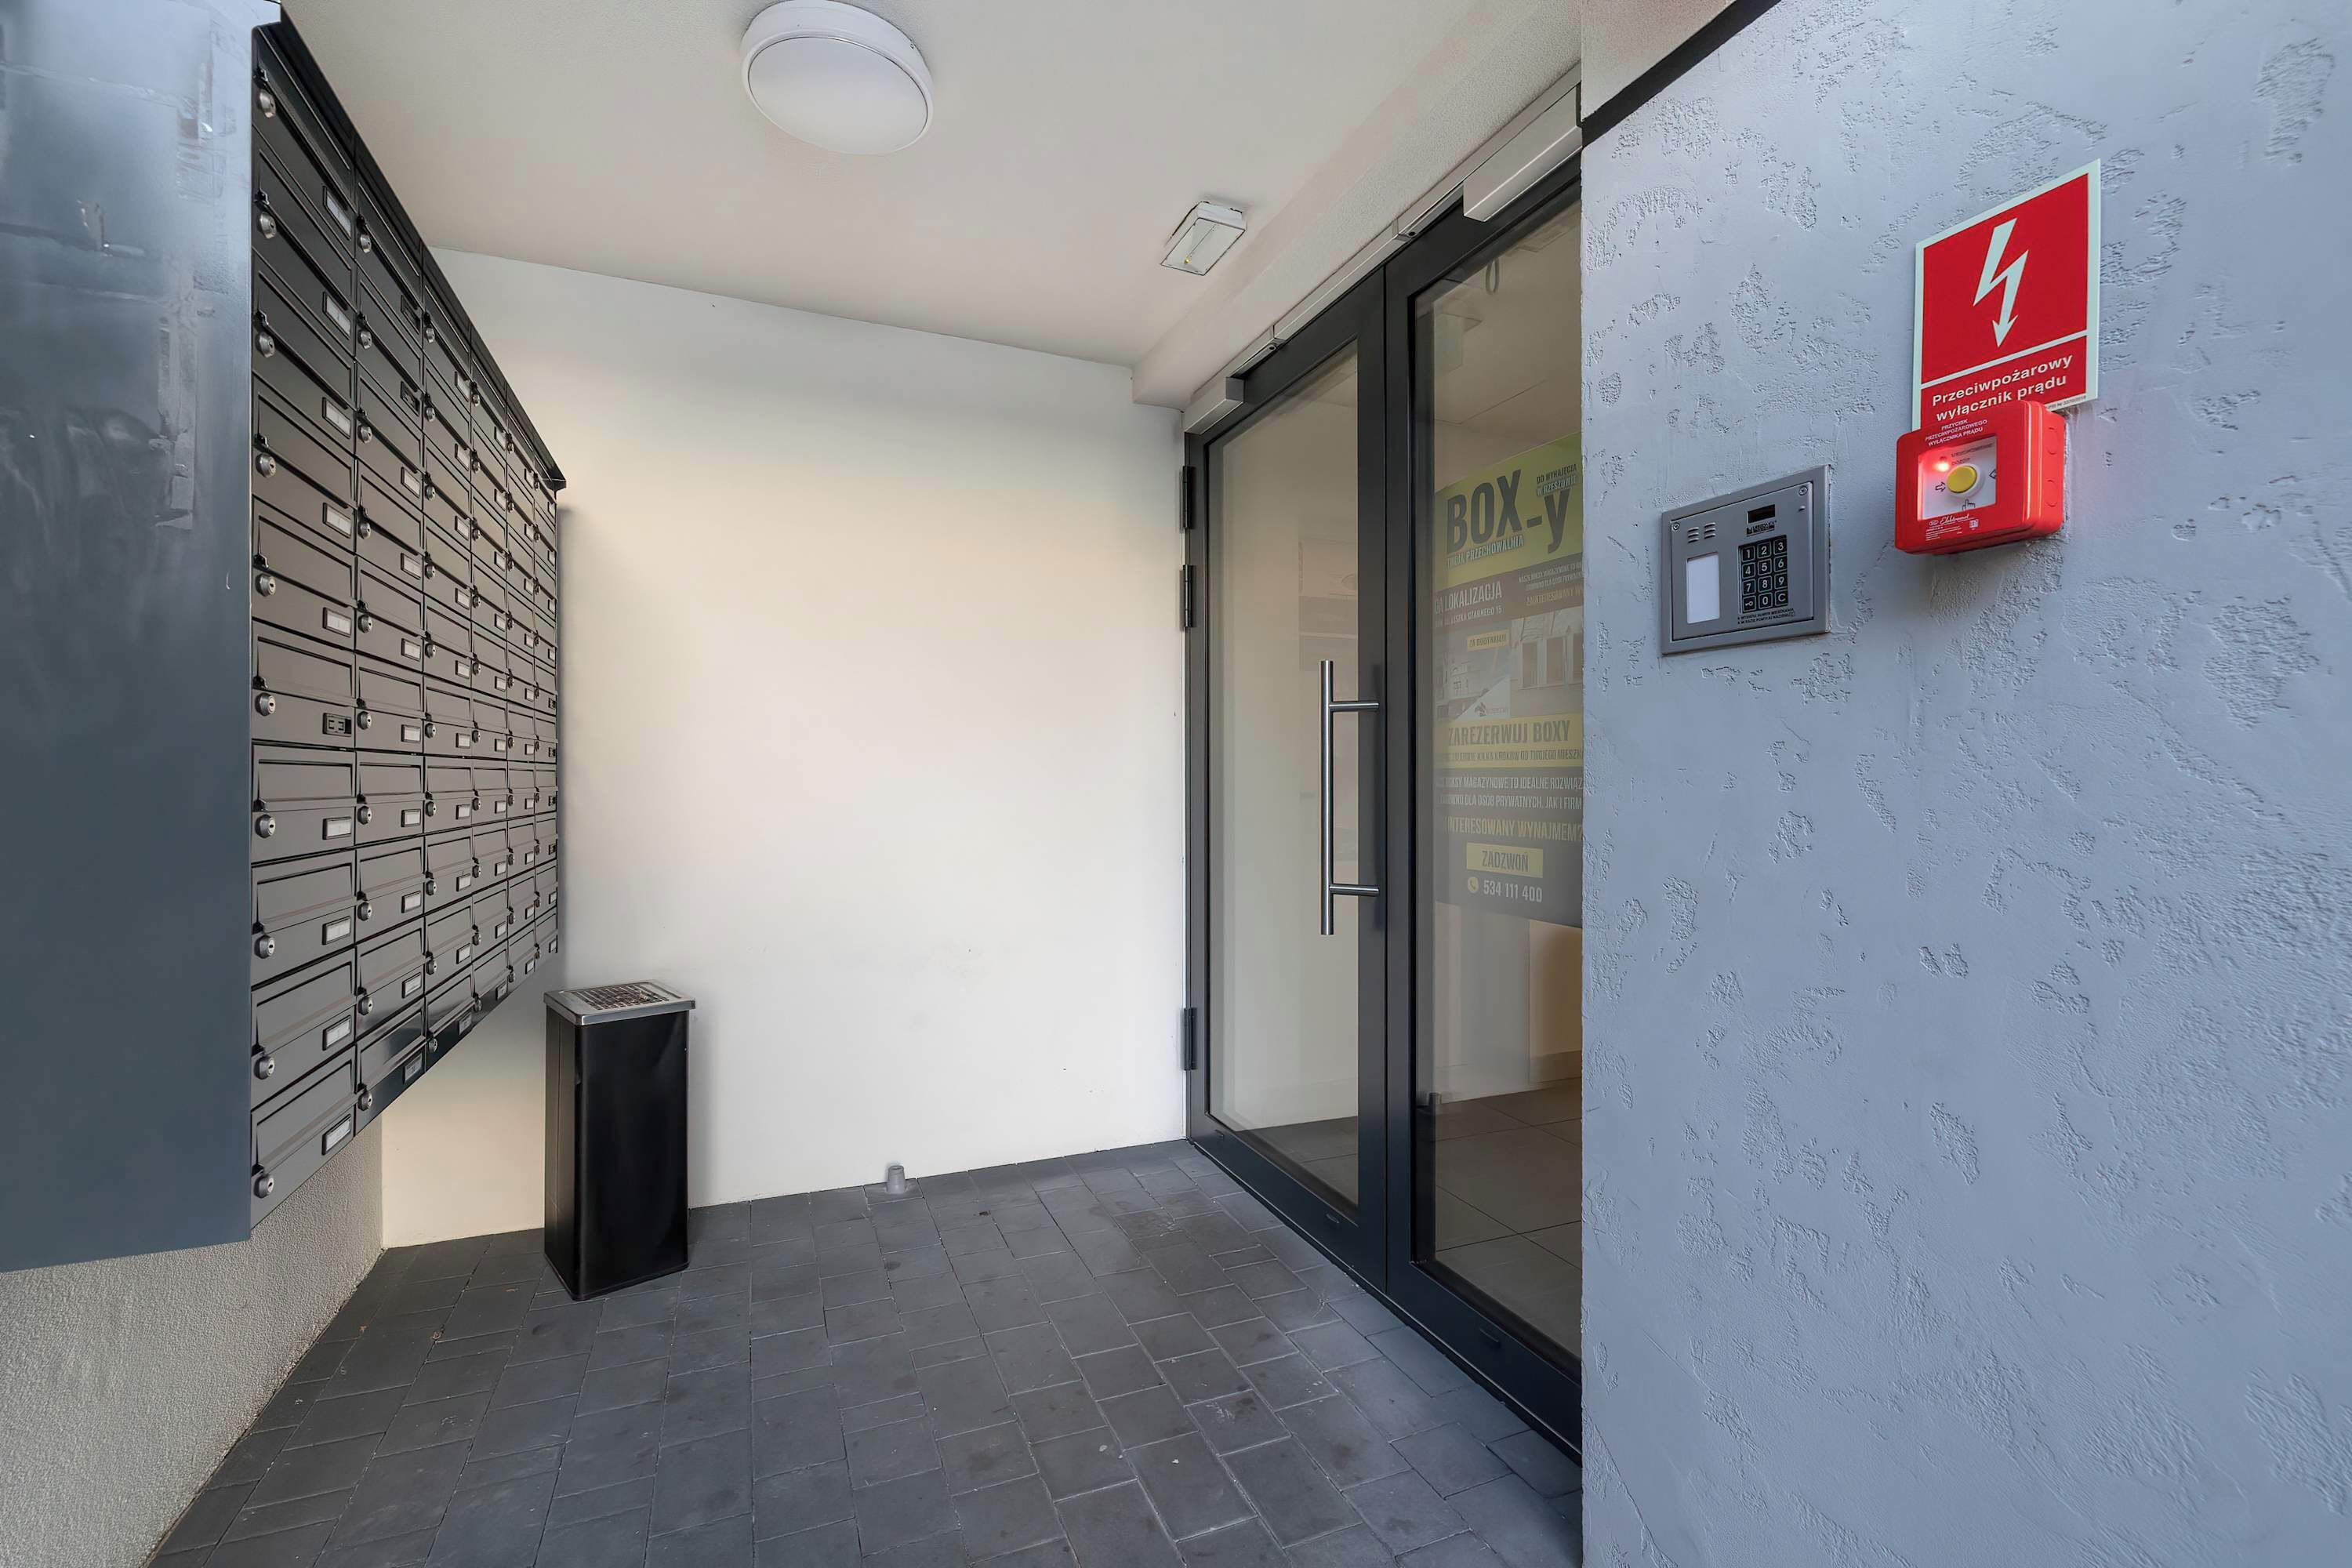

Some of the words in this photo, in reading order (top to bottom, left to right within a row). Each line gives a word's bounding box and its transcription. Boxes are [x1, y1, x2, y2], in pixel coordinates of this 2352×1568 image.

[1933, 354, 2073, 406] Przeciwpożarowy
[1936, 391, 2012, 422] wyłącznik
[2017, 376, 2067, 401] prądu
[1941, 419, 1969, 430] PRZYCISK
[1465, 535, 1524, 561] PRZECHOWALNIA
[1746, 549, 1751, 559] 1
[1761, 546, 1767, 555] 2
[1777, 542, 1784, 550] 3
[1745, 565, 1751, 574] 4
[1761, 562, 1767, 571] 5
[1778, 558, 1784, 567] 6
[1746, 583, 1751, 592] 7
[1762, 579, 1767, 588] 8
[1779, 575, 1784, 584] 9
[1445, 581, 1502, 611] LOKALIZACJA
[1762, 596, 1768, 605] 0
[1449, 724, 1527, 746] ZAREZERWUJ
[1533, 720, 1569, 743] BOXY
[1482, 851, 1529, 872] ZADZWOŃ
[1483, 880, 1501, 896] 534
[1505, 883, 1519, 899] 111
[1522, 885, 1543, 902] 400
